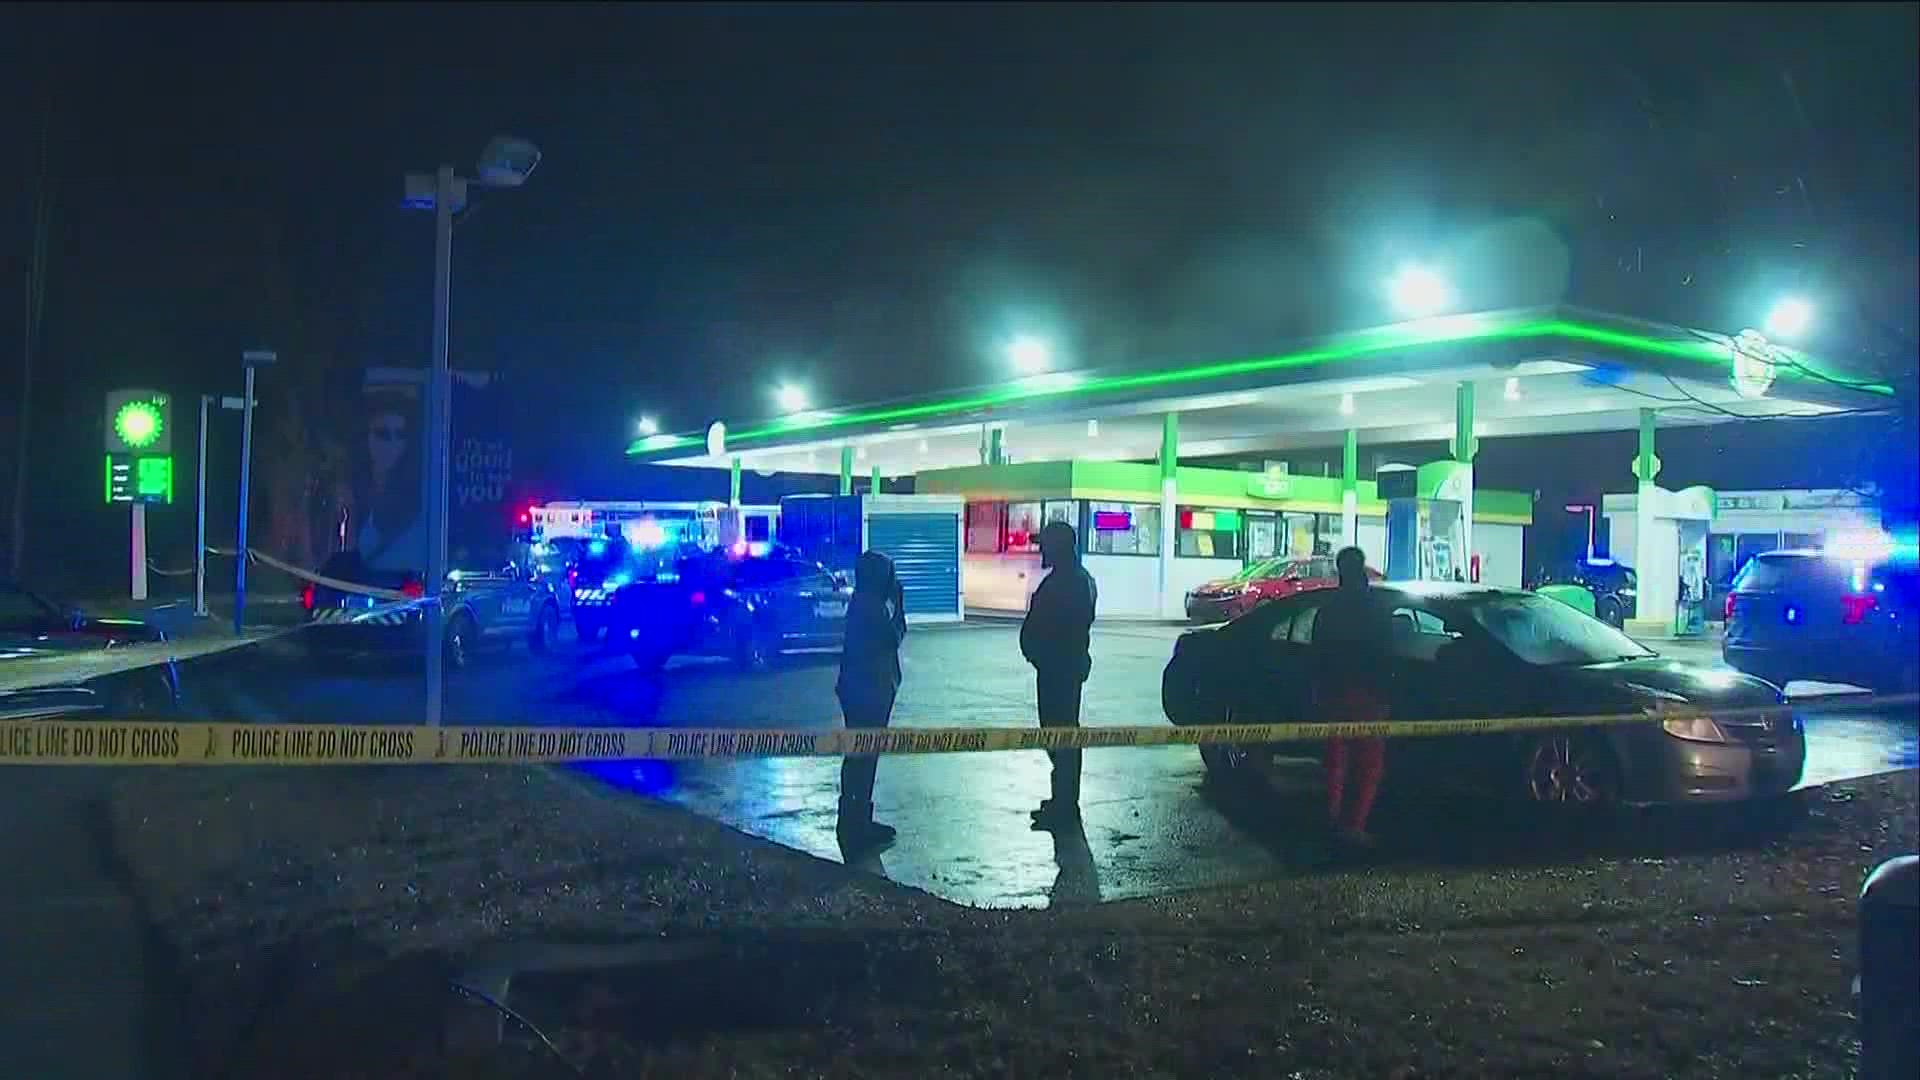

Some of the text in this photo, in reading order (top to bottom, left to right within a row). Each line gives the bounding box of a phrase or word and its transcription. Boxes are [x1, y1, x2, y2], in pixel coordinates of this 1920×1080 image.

[37, 728, 69, 757] LINE
[73, 728, 94, 756] DO
[98, 728, 128, 758] NOT
[132, 728, 179, 758] CROSS
[232, 729, 414, 759] POLICE LINE DO NOT CROSS
[461, 733, 625, 758] POLICE LINE DO NOT CROSS
[668, 733, 708, 757] POLICE
